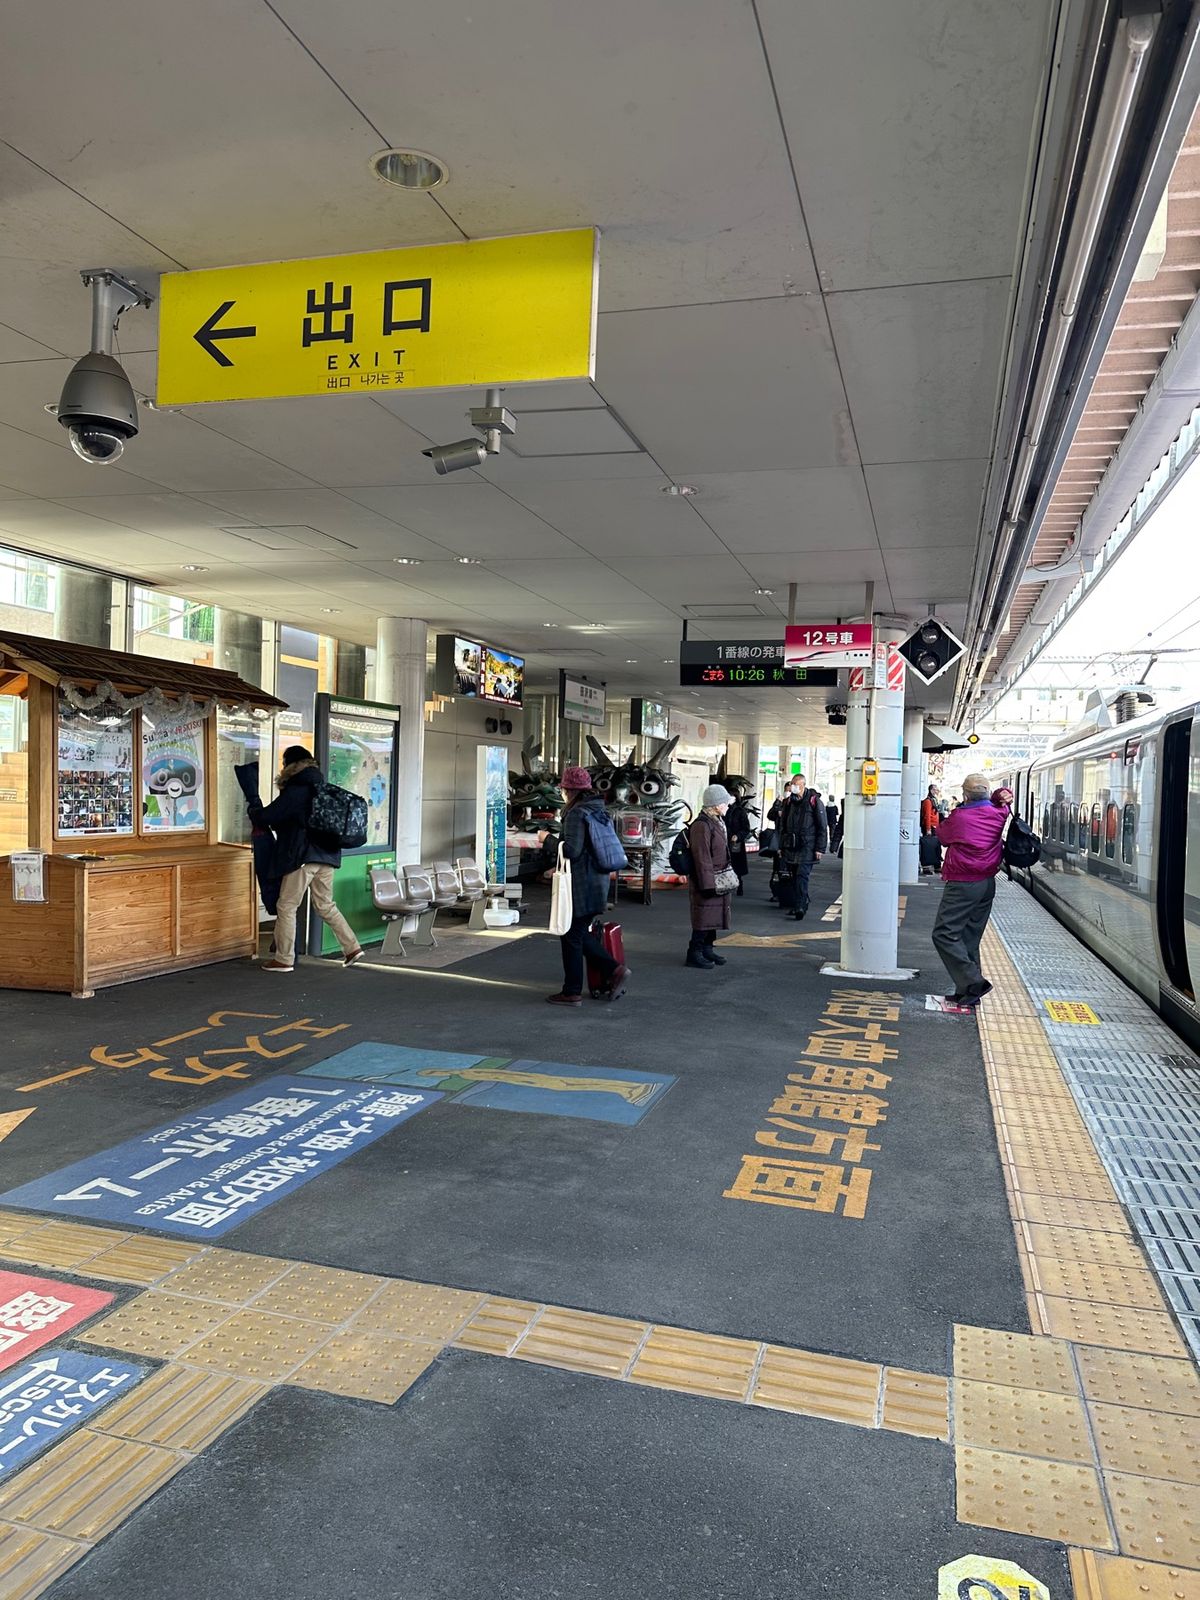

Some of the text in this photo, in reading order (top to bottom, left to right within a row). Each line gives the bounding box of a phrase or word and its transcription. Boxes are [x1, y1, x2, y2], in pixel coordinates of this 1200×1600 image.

[302, 278, 432, 347] 出口
[327, 350, 406, 370] EXIT
[326, 371, 405, 388] 出口 나가는 곳
[803, 631, 854, 646] 12号車
[702, 668, 807, 681] こまち 10:26 秋田
[355, 1089, 383, 1100] For
[279, 1098, 360, 1141] Kakunodate
[142, 1122, 203, 1144] Track
[53, 1087, 346, 1201] 1番線ホーム
[186, 1181, 210, 1189] &
[134, 1188, 196, 1215] Akita
